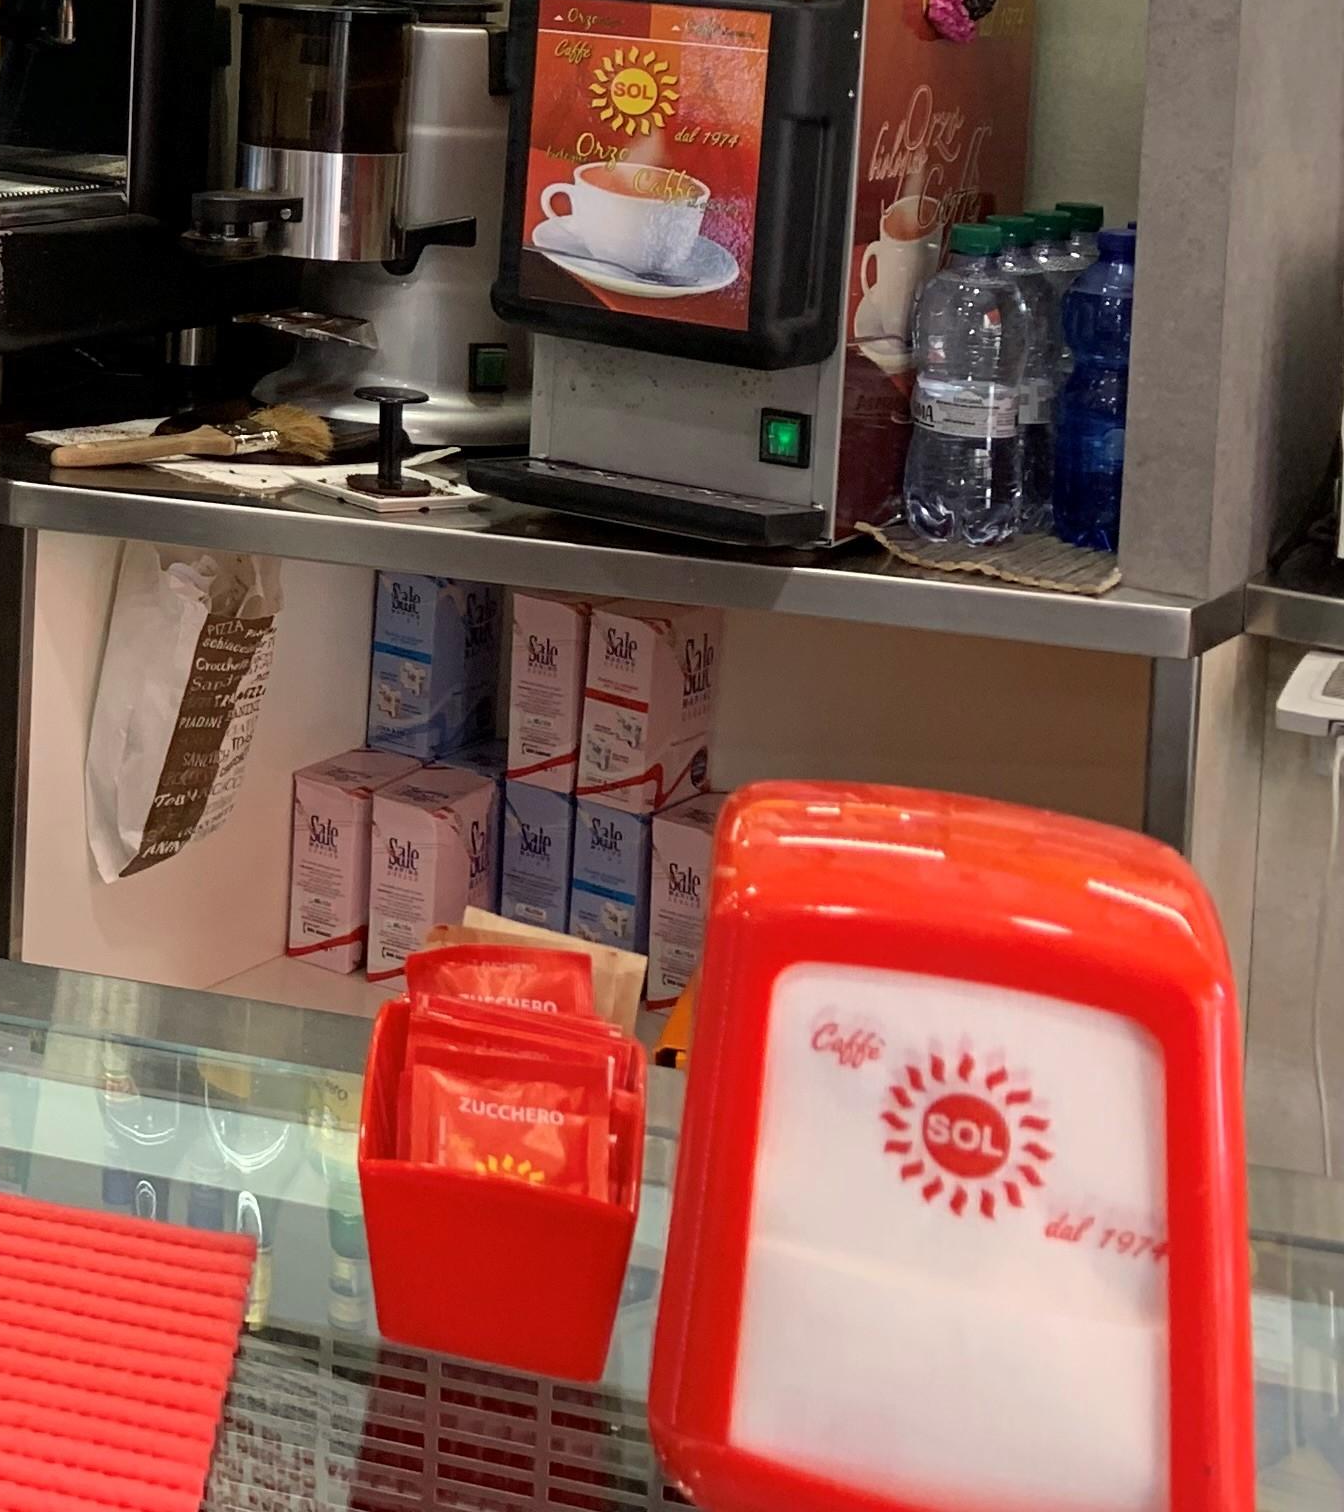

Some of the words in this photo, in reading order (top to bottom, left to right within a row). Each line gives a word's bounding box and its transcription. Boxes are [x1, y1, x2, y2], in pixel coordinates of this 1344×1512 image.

[614, 82, 653, 100] SOL
[576, 133, 630, 169] Orzo
[674, 127, 701, 143] dal
[702, 132, 739, 148] 1974
[207, 620, 245, 636] PIZZA
[606, 627, 638, 661] Sale
[310, 814, 340, 849] Sale
[389, 835, 420, 870] Sale
[458, 1096, 566, 1129] ZUCCHERO
[926, 1113, 1005, 1162] SOL
[1046, 1210, 1095, 1246] dal
[1099, 1226, 1169, 1266] 1974
